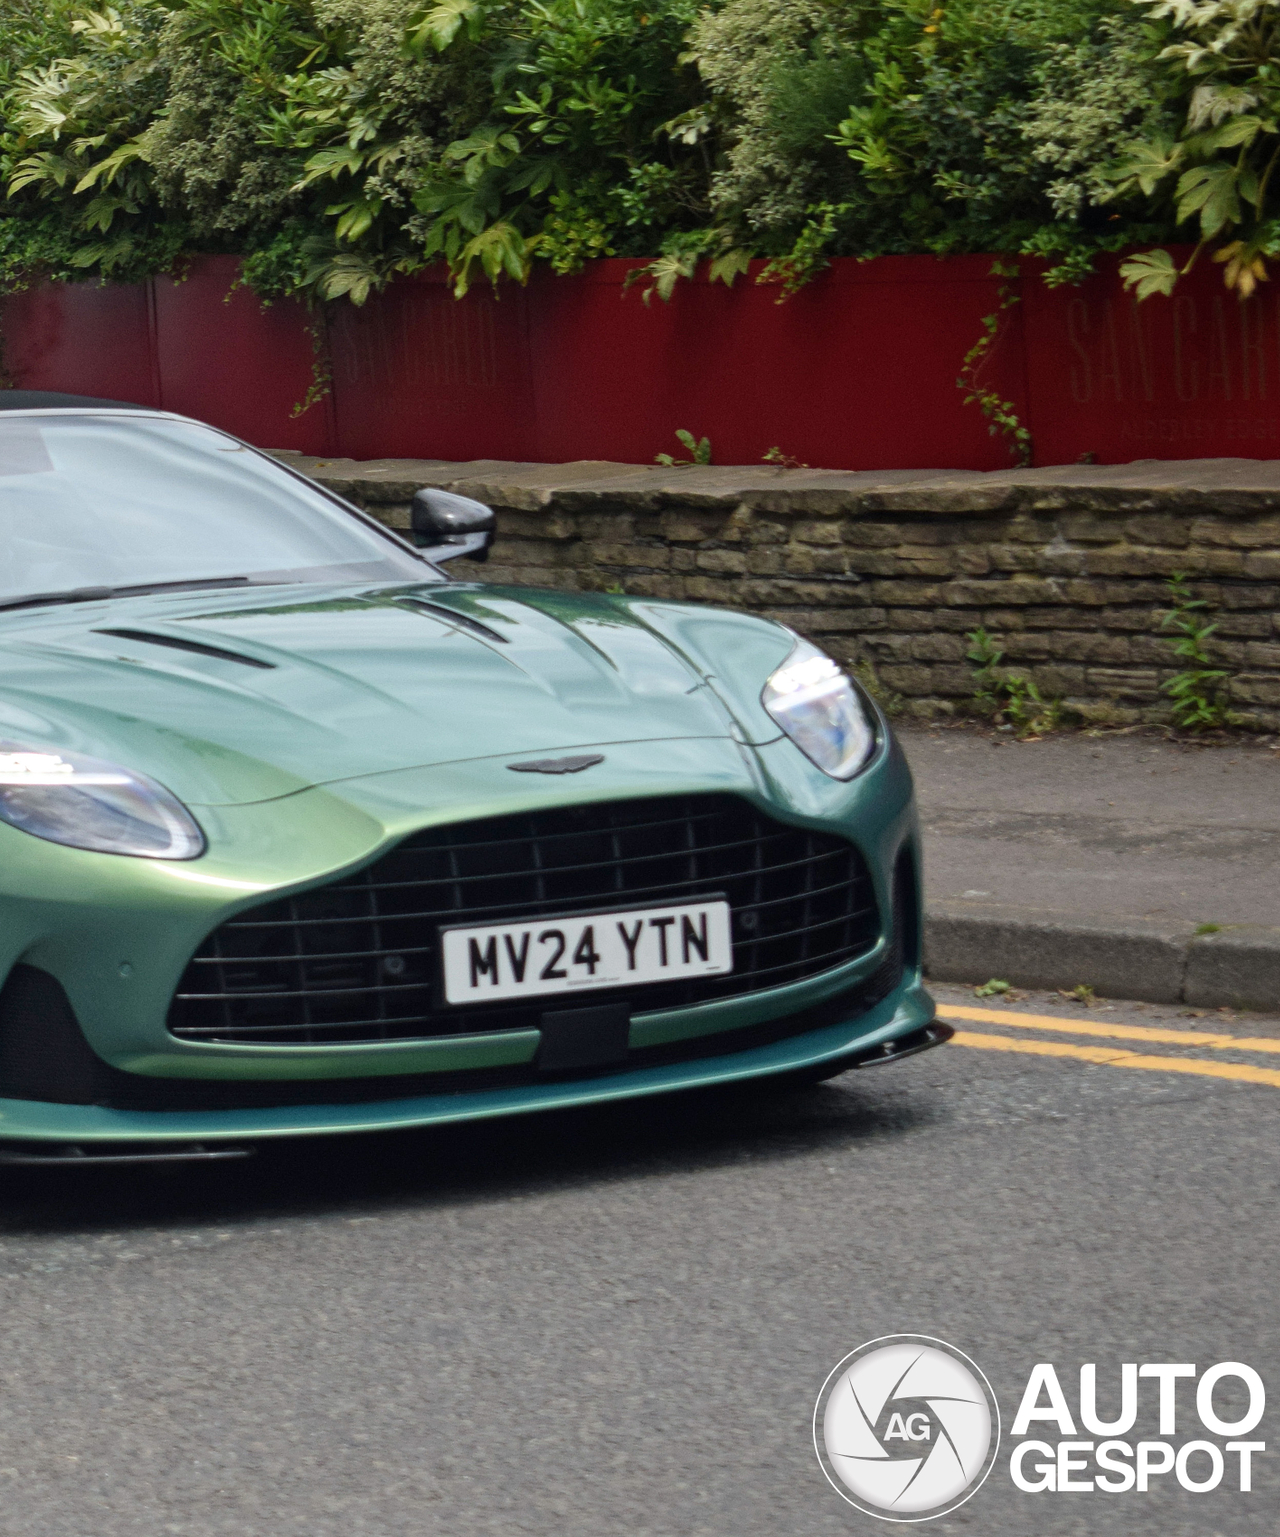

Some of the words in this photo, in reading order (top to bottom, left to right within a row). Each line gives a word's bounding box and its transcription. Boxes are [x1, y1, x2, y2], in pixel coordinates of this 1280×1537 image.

[1066, 298, 1154, 404] SAN
[467, 924, 601, 988] MV24
[616, 911, 709, 971] YTN
